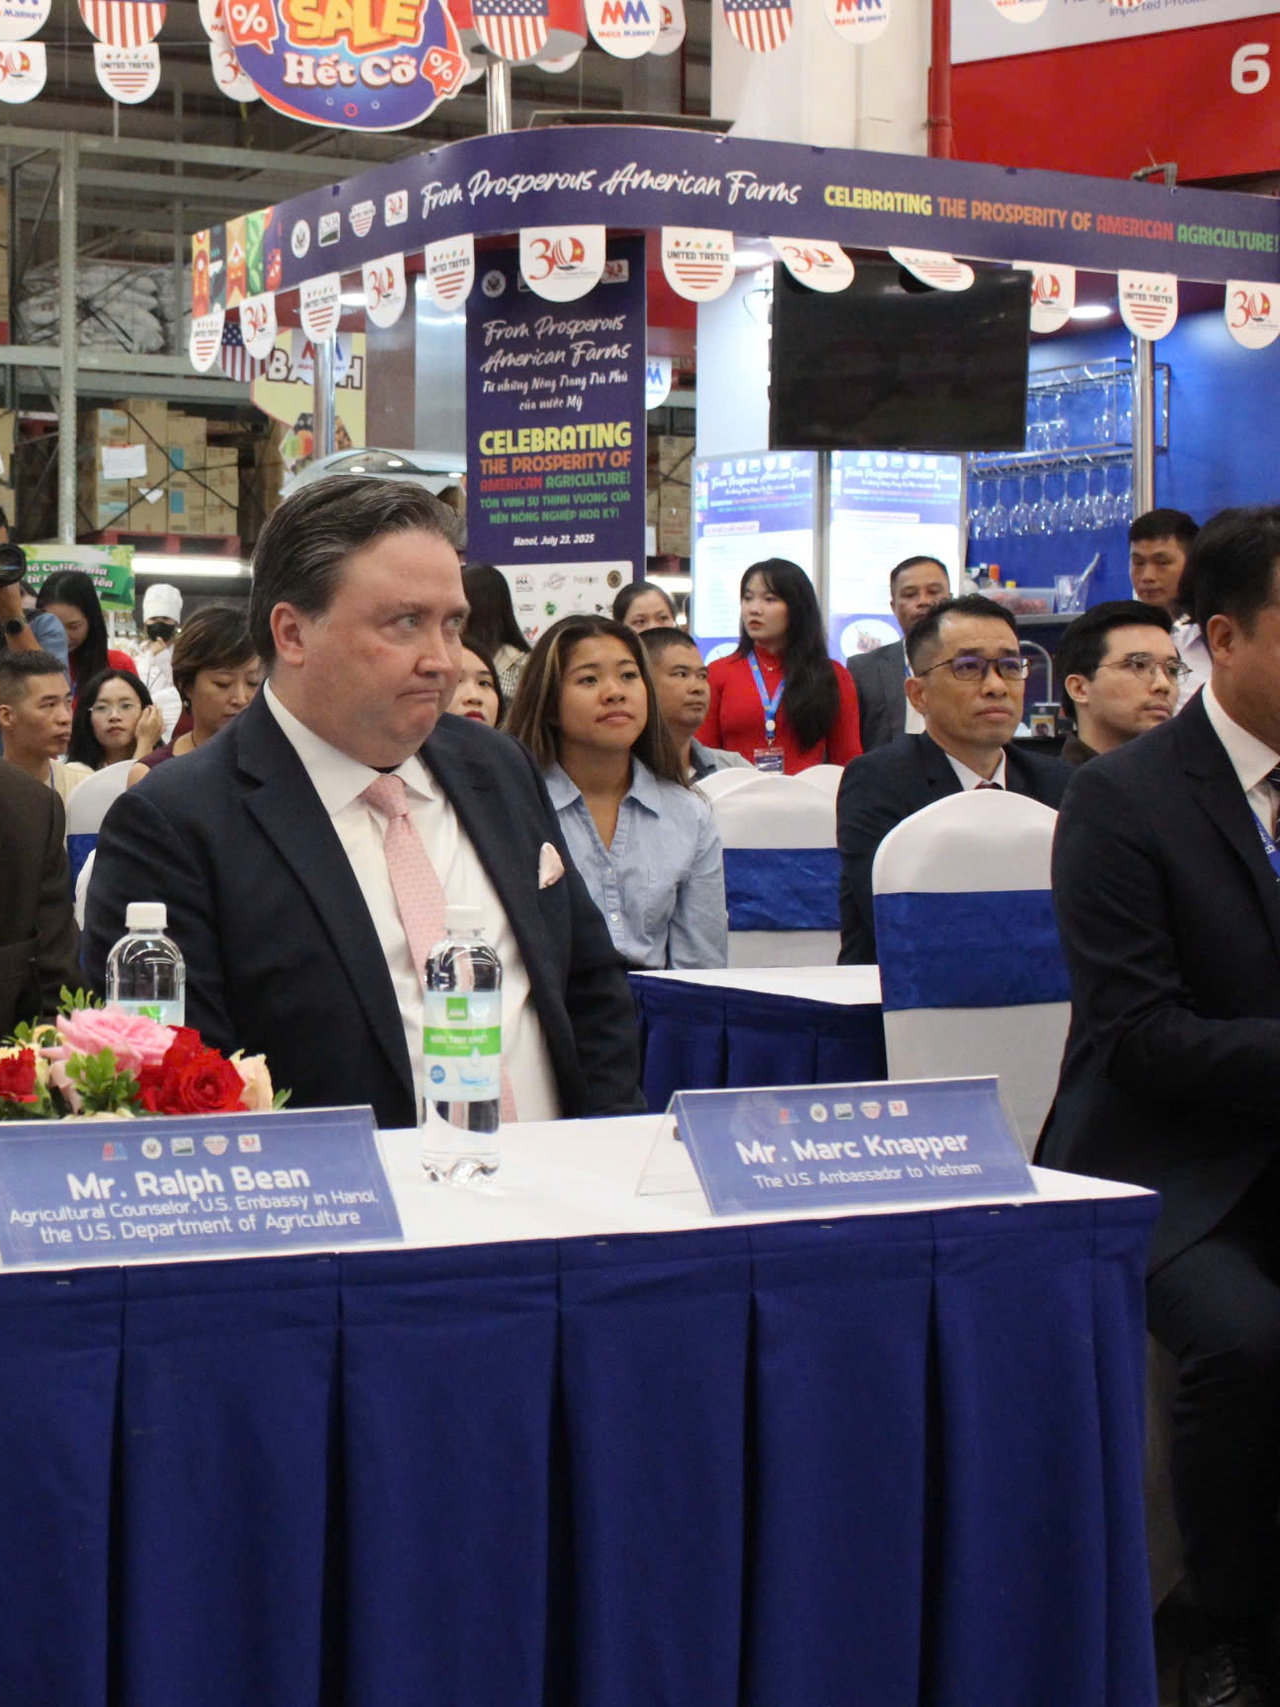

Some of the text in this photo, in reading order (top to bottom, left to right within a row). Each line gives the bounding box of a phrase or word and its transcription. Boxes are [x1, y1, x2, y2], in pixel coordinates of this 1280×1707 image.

[289, 0, 420, 48] SALE
[101, 61, 126, 69] UNITED
[283, 52, 357, 87] Hết
[1231, 43, 1270, 94] 6
[420, 162, 803, 219] From Prosperous American Farms
[824, 185, 1280, 254] CELEBRATING THE PROSPERITY OF AMERICAN AGRICULTURE!
[529, 236, 586, 280] 30
[667, 250, 698, 260] UNITED
[1123, 292, 1147, 302] UNITED
[1231, 291, 1271, 328] 30
[482, 315, 627, 346] From Prosperous
[480, 340, 632, 374] American Farms
[479, 421, 632, 456] CELEBRATING
[480, 450, 632, 475] THE PROSPERITY OF
[480, 471, 631, 492] AMERICAN AGRICULTURE!
[540, 535, 559, 547] July
[573, 533, 596, 545] 2025
[735, 1133, 969, 1165] Mr. Marc Knapper
[67, 1165, 311, 1201] Mr. Ralph Bean
[753, 1161, 983, 1189] The U.S. Ambassador to Vietnam
[10, 1204, 105, 1228] Agricultural
[199, 1196, 232, 1213] U.S.
[236, 1193, 308, 1211] Embassy
[314, 1192, 329, 1206] in
[40, 1210, 361, 1244] the U.S. Department of Agriculture
